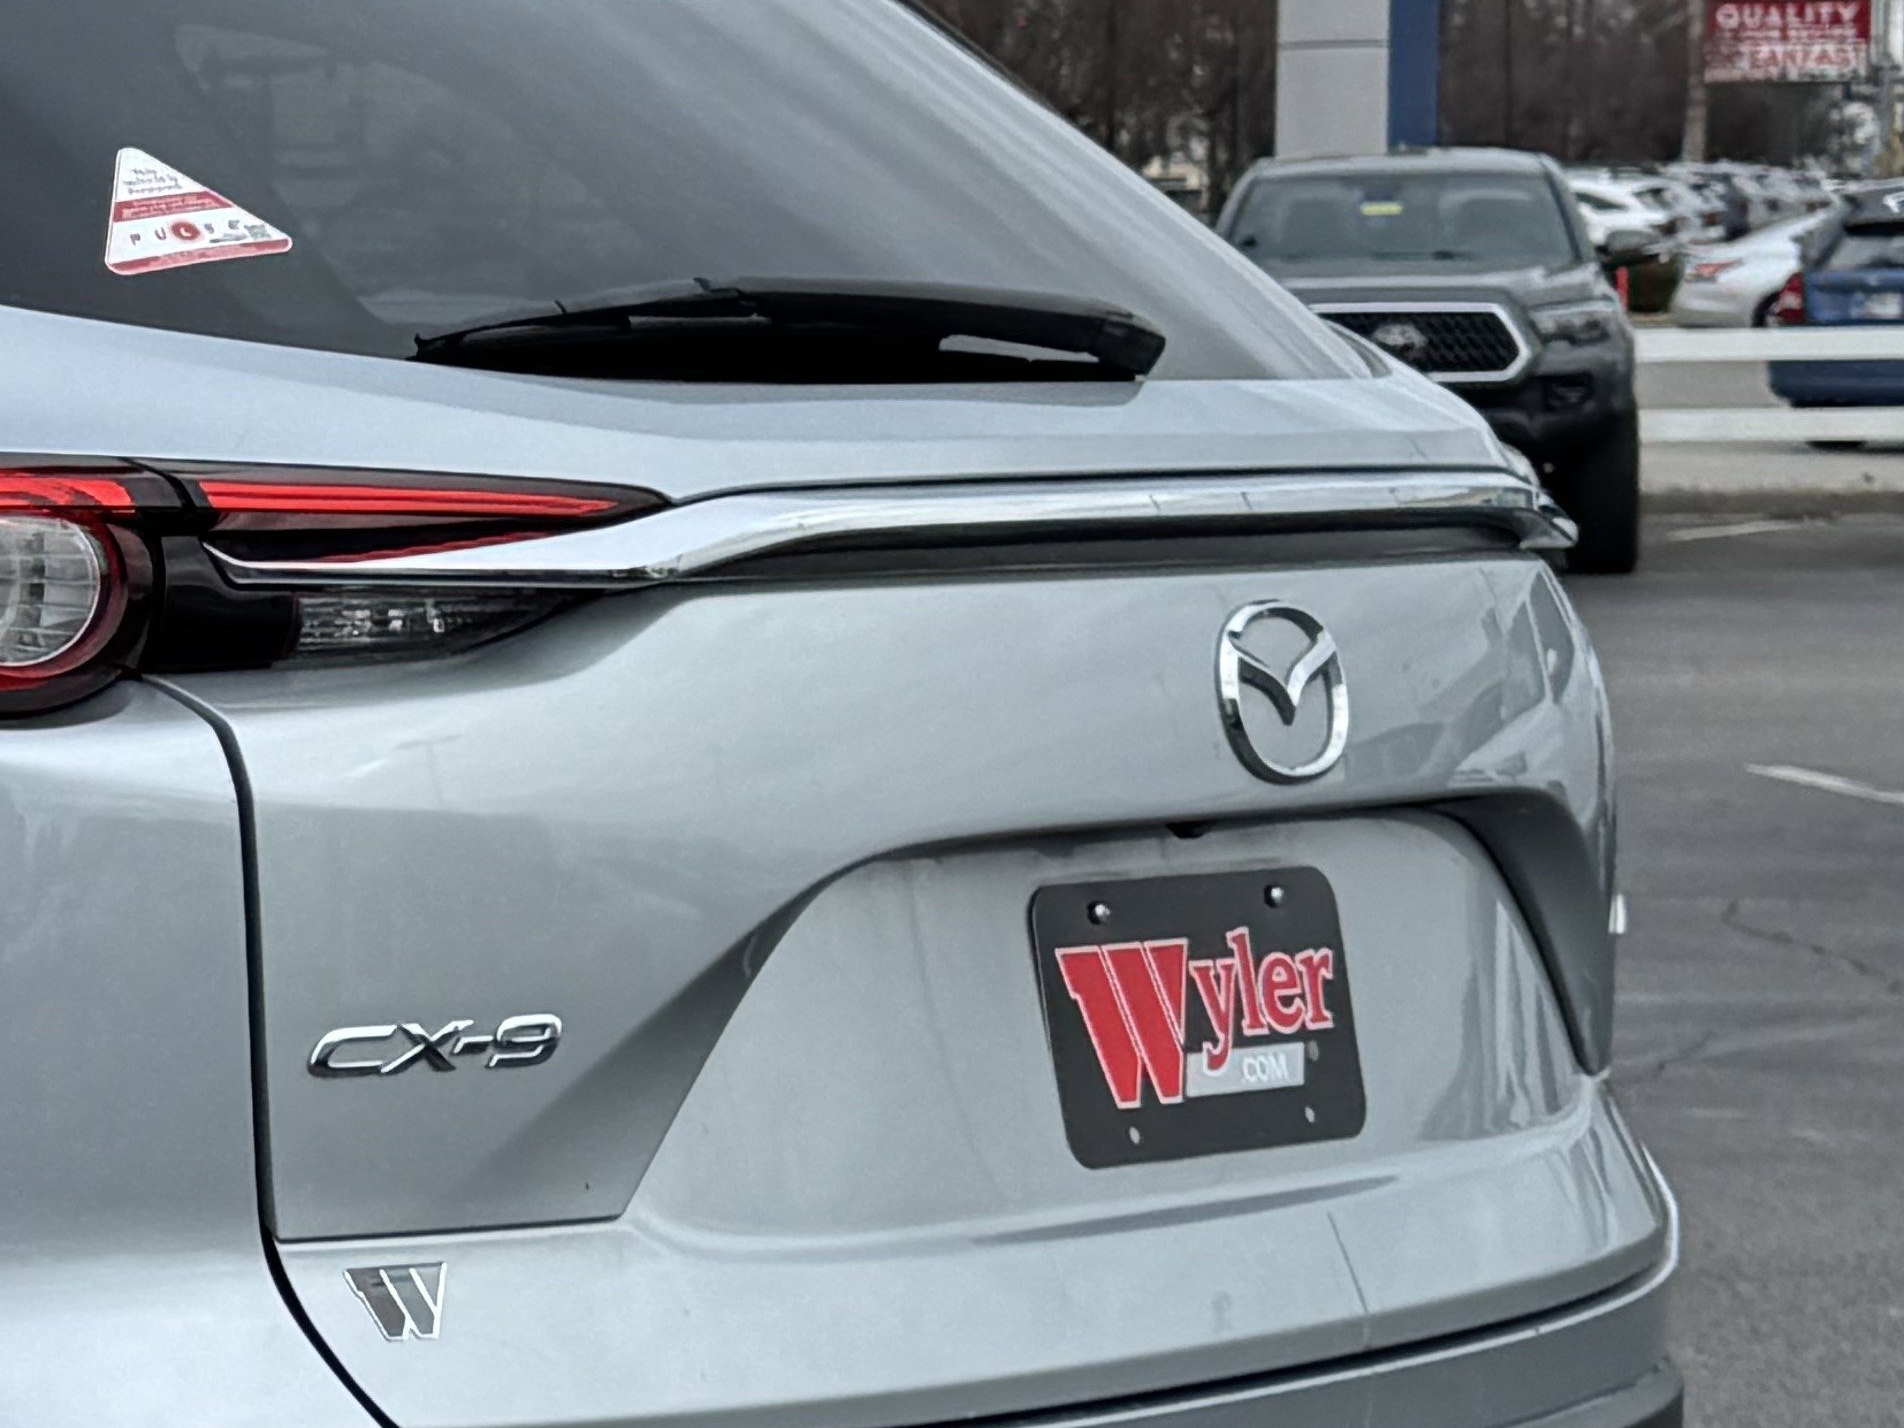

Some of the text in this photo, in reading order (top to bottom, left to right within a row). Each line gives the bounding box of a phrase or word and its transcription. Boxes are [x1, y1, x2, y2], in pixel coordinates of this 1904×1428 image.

[1715, 3, 1861, 29] QUALITY
[307, 1013, 563, 1078] CX-9
[1054, 926, 1335, 1109] Wyler
